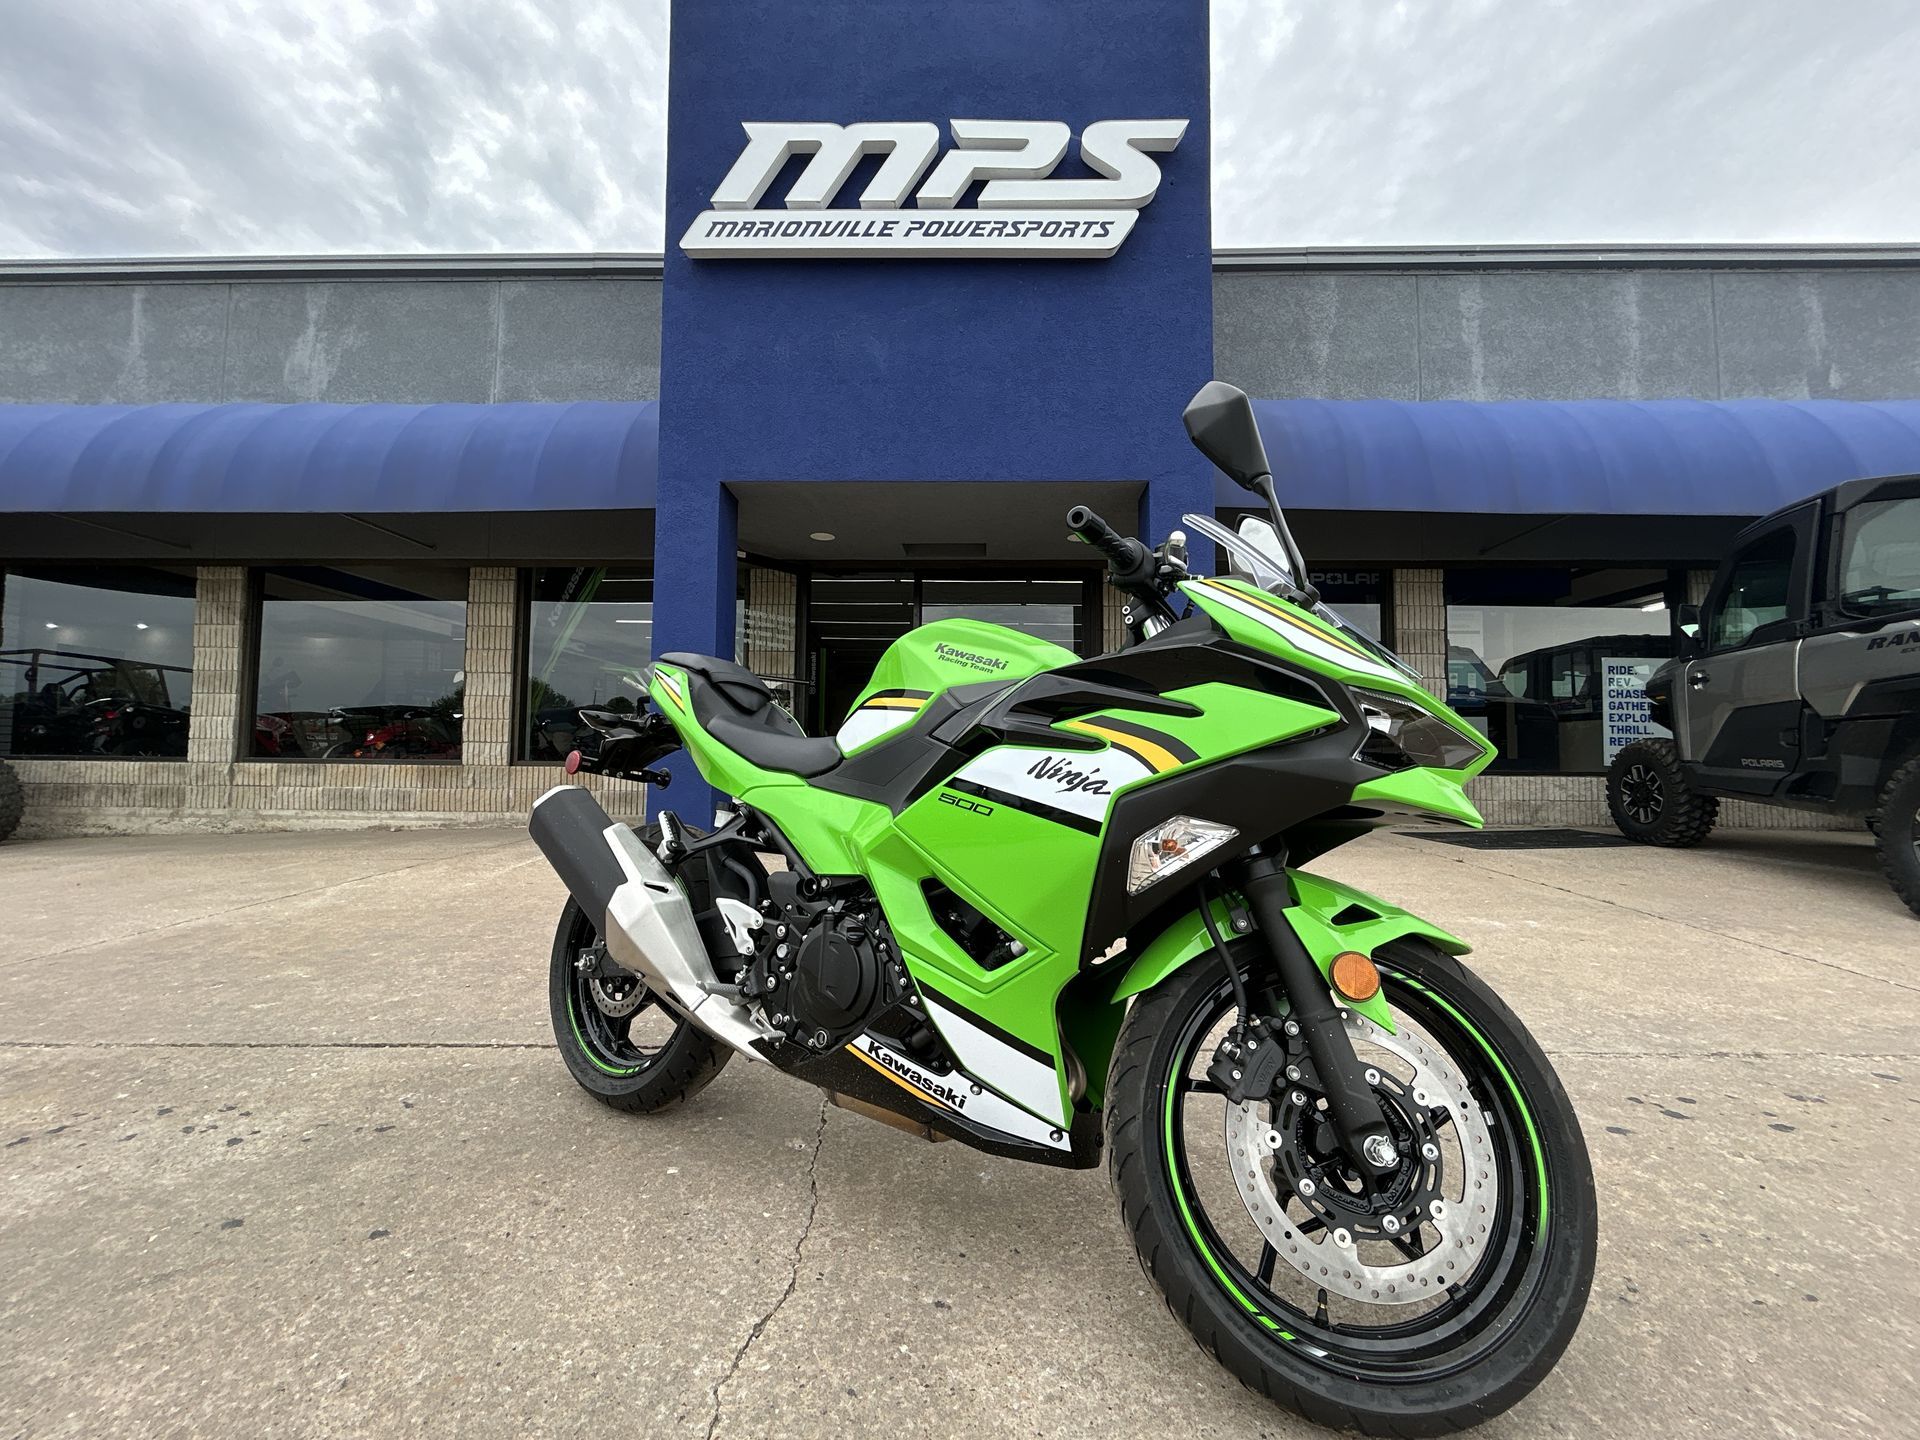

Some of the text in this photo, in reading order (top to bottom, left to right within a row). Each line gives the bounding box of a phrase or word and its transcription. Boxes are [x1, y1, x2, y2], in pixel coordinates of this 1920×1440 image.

[710, 118, 1190, 210] MPS
[705, 219, 1115, 239] MARIONVILLE POWERSPORTS
[934, 642, 1009, 671] Kawasaki
[938, 654, 994, 674] Racing Team
[1608, 666, 1637, 675] RIDE.
[1608, 678, 1634, 687] REV.
[1609, 725, 1654, 735] THRILL.
[1741, 758, 1785, 768] POLARIS
[1027, 755, 1111, 796] Ninja
[937, 792, 994, 817] 500
[868, 1041, 967, 1109] Kawasaki
